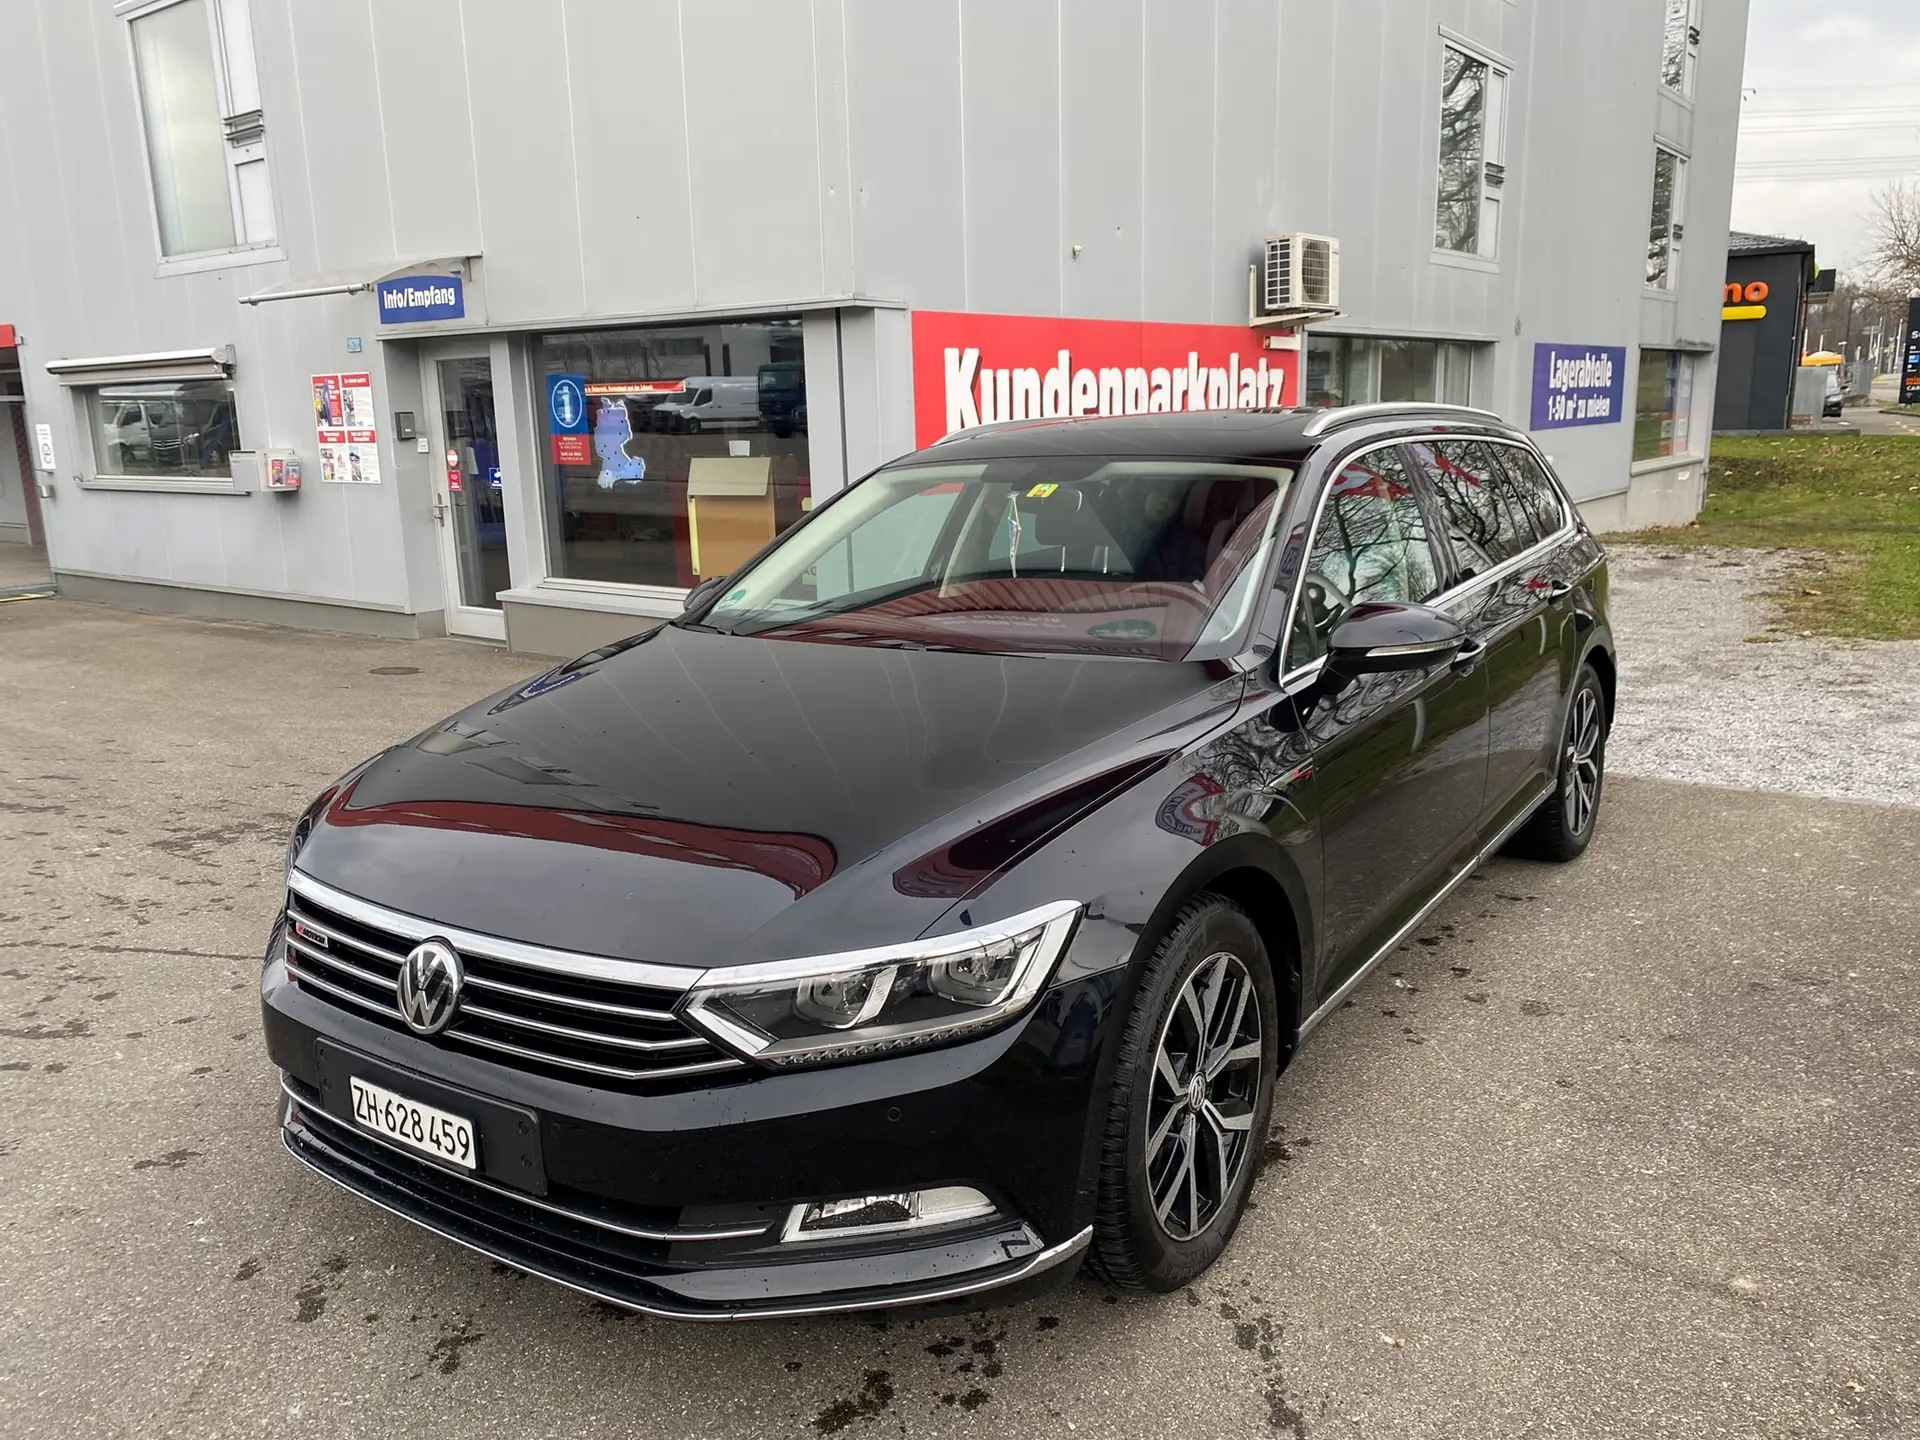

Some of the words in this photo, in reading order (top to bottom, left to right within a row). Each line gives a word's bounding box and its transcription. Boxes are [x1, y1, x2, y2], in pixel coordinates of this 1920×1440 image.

[383, 285, 456, 310] Info/Empfang
[1549, 351, 1612, 392] Lagerabteile
[944, 347, 1286, 433] Kundenparkplatz
[1587, 393, 1610, 418] mieten
